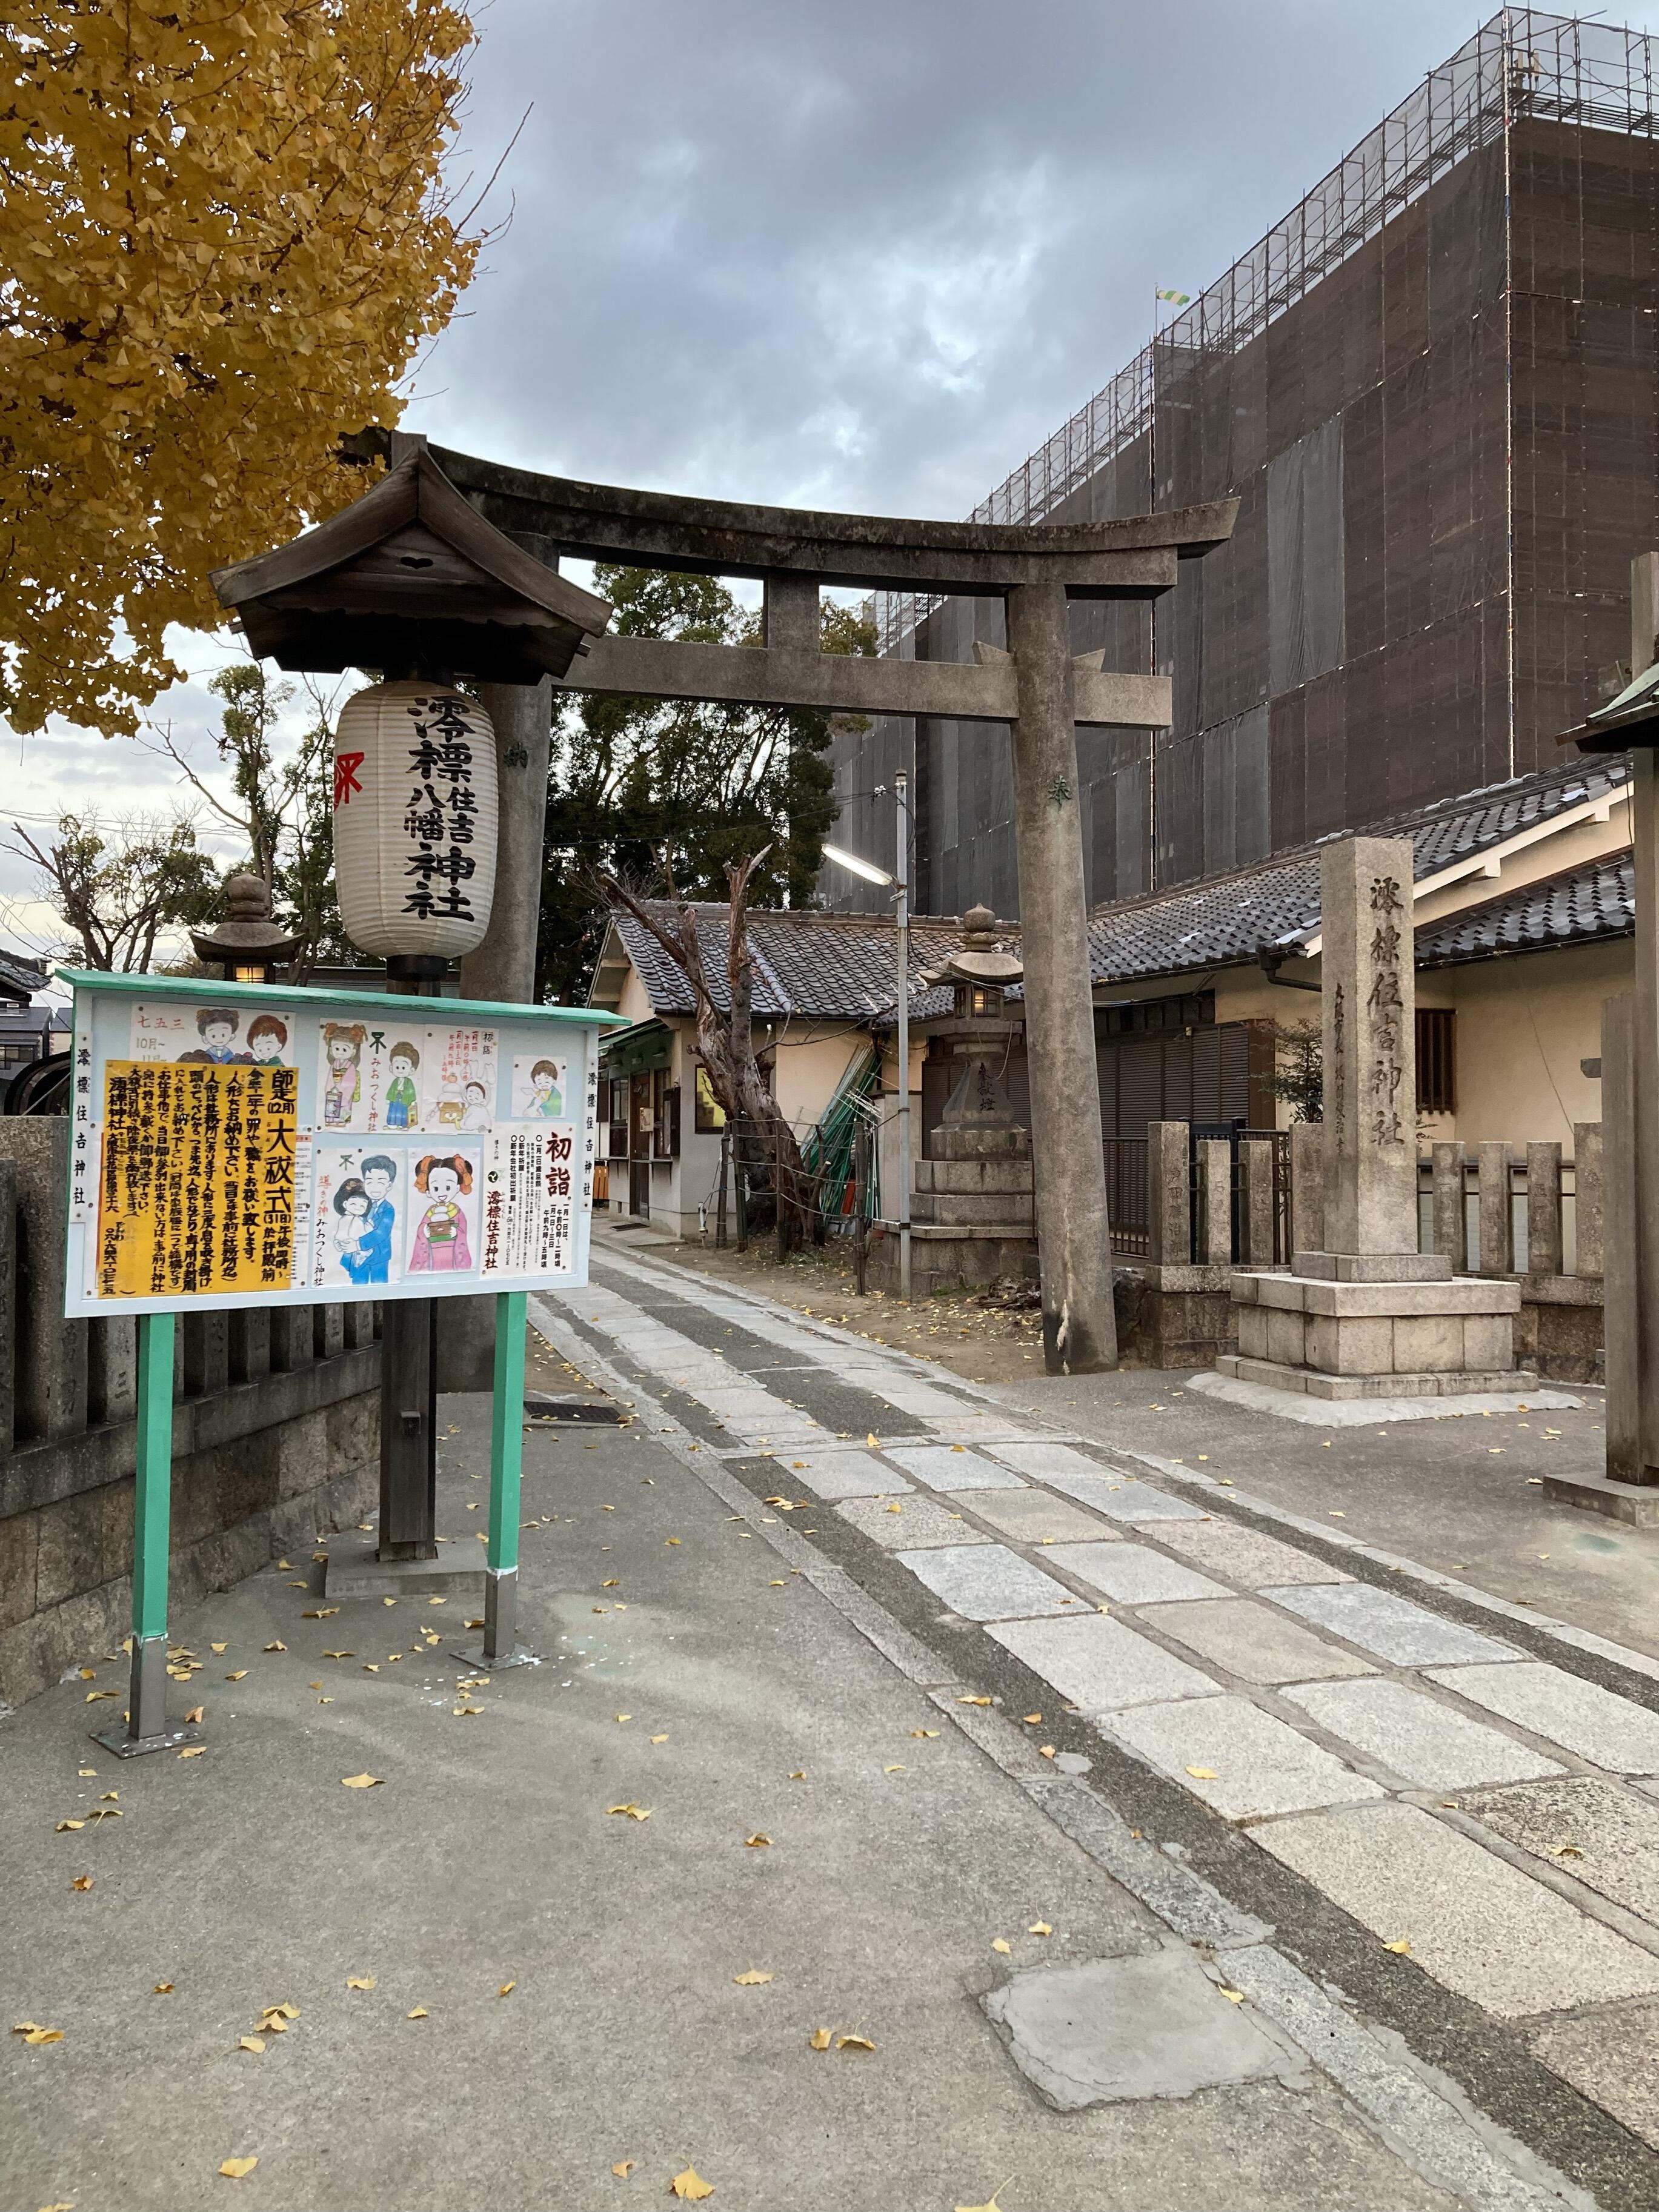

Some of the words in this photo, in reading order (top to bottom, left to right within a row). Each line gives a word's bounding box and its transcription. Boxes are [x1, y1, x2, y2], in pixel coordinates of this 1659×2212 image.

[404, 783, 446, 841] 八幡
[445, 787, 478, 844] 住吉
[401, 842, 476, 922] 神社
[138, 1015, 184, 1030] 七五三
[483, 1032, 493, 1054] 初詣
[1366, 876, 1405, 1146] 澪標住吉神社
[367, 1058, 381, 1132] みおつくし神社
[316, 1175, 330, 1216] 導きの神
[545, 1132, 571, 1197] 初詣
[313, 1219, 327, 1287] みおつくし神社
[484, 1191, 502, 1269] 澪標住吉神社
